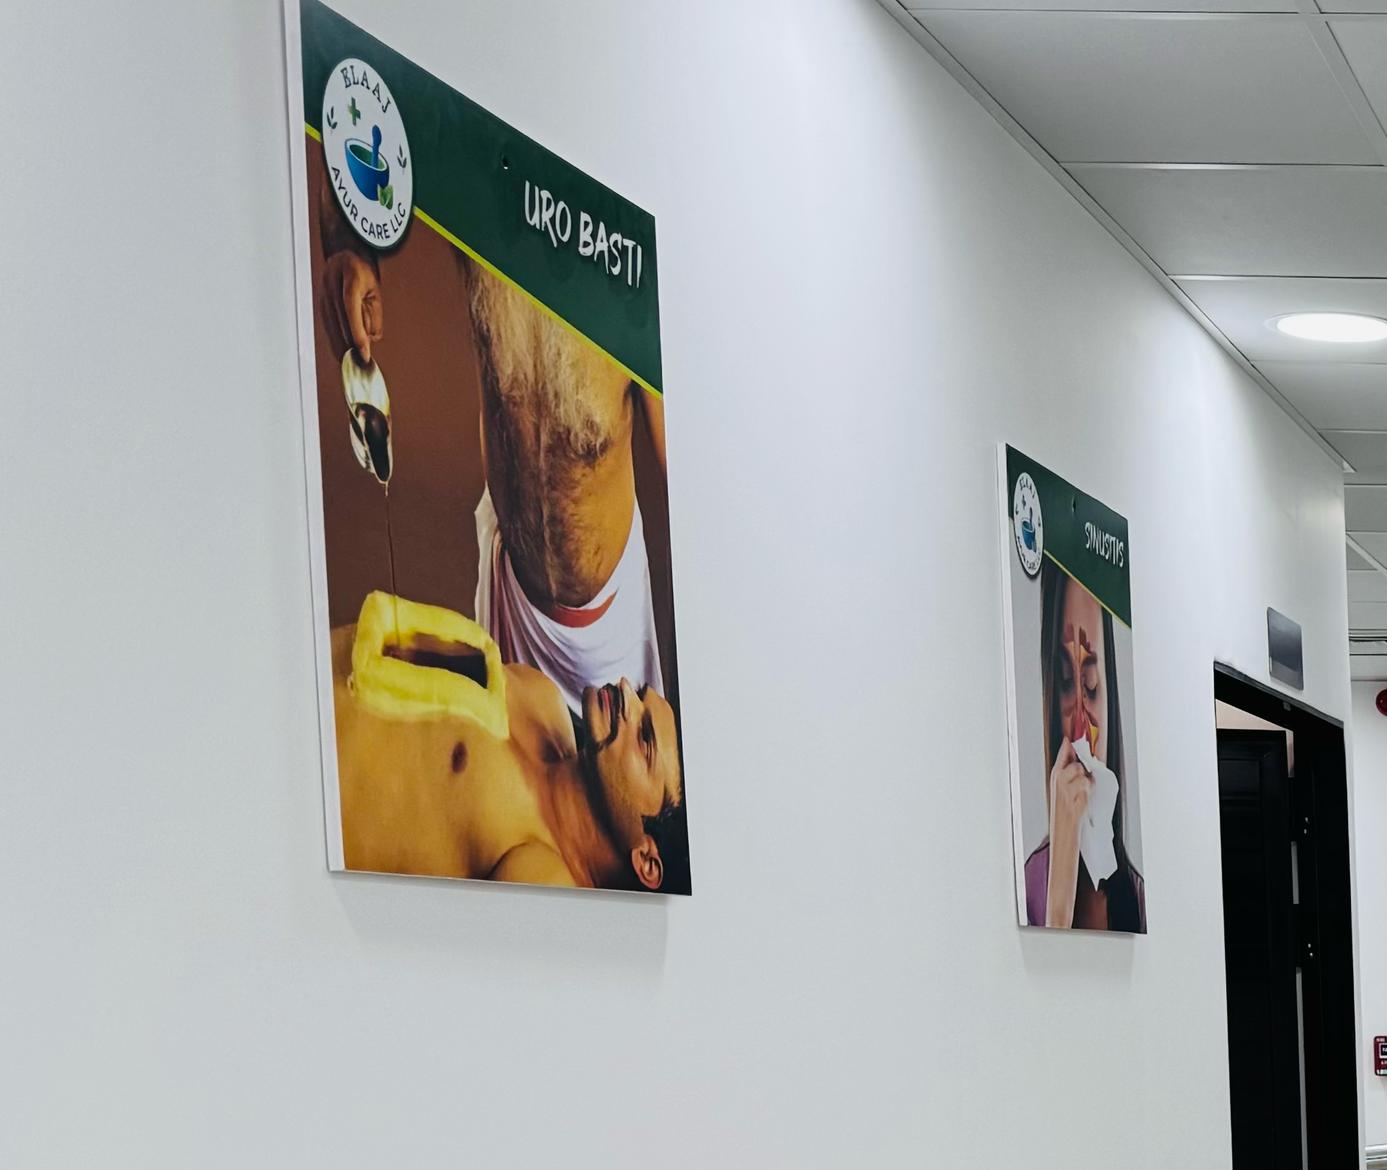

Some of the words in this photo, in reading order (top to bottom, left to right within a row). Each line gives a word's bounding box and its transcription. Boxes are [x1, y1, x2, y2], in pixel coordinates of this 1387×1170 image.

[331, 166, 358, 222] AYUR
[361, 216, 390, 240] CARE
[390, 202, 407, 234] LLC
[524, 180, 571, 248] URO
[578, 211, 643, 289] BASTI
